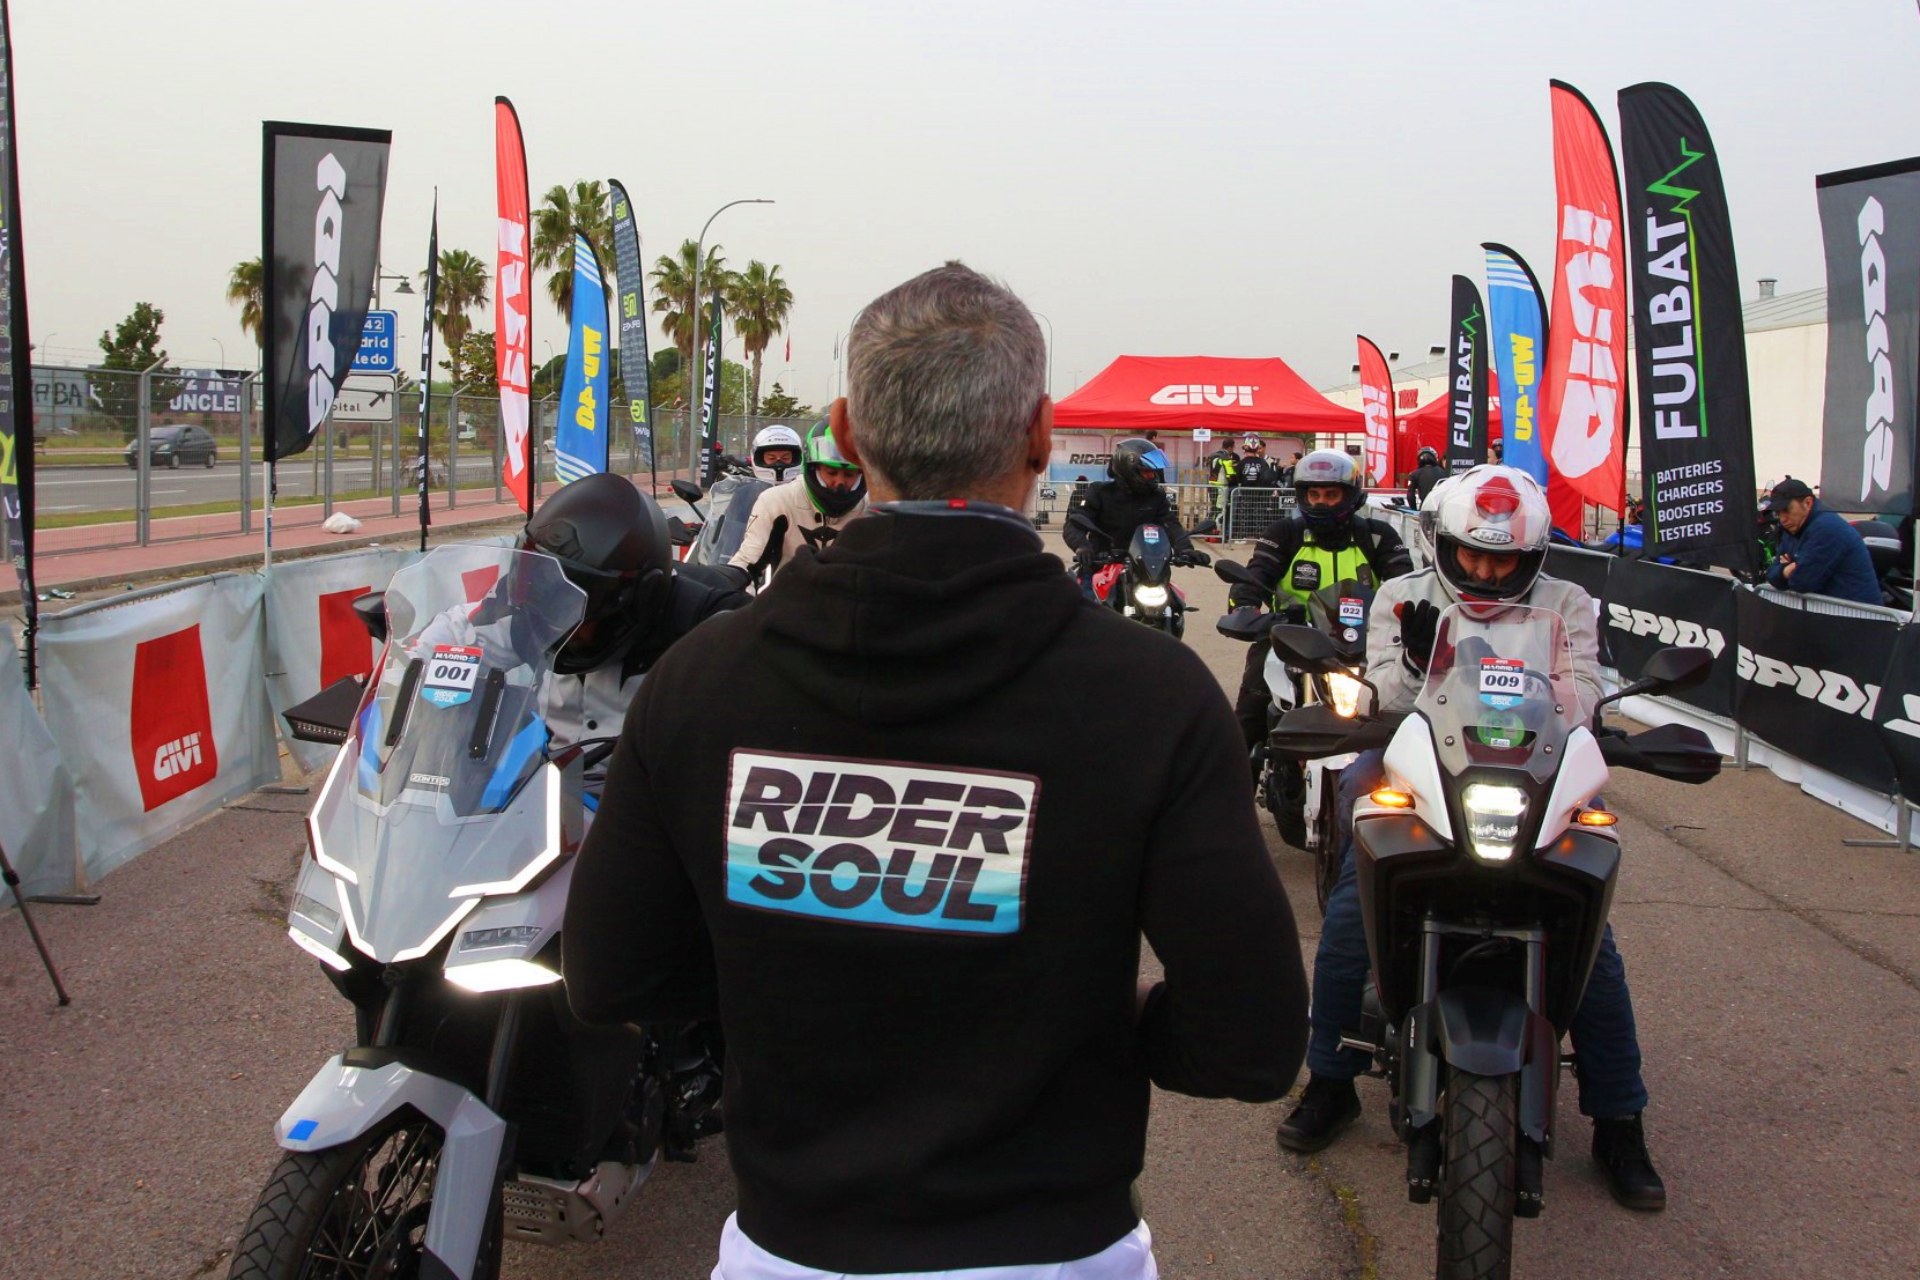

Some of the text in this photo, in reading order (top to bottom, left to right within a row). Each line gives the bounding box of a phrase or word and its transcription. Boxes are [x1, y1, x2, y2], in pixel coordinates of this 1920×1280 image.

[308, 152, 346, 434] SPIDI
[1646, 213, 1699, 440] FULBAT
[702, 339, 715, 439] FULBAT
[1150, 384, 1254, 407] GIVI
[1453, 334, 1473, 448] FULBAT
[1657, 460, 1723, 485] BATTERIES
[1657, 479, 1724, 503] CHARGERS
[1658, 500, 1725, 523] BOOSTERS
[1659, 521, 1722, 543] TESTERS
[1342, 606, 1361, 615] 022
[1608, 602, 1726, 659] SPIDI
[434, 664, 472, 682] 001
[1485, 674, 1520, 687] 009
[153, 730, 203, 782] GIVI
[732, 765, 1027, 856] RIDER
[747, 837, 999, 923] SOUL
